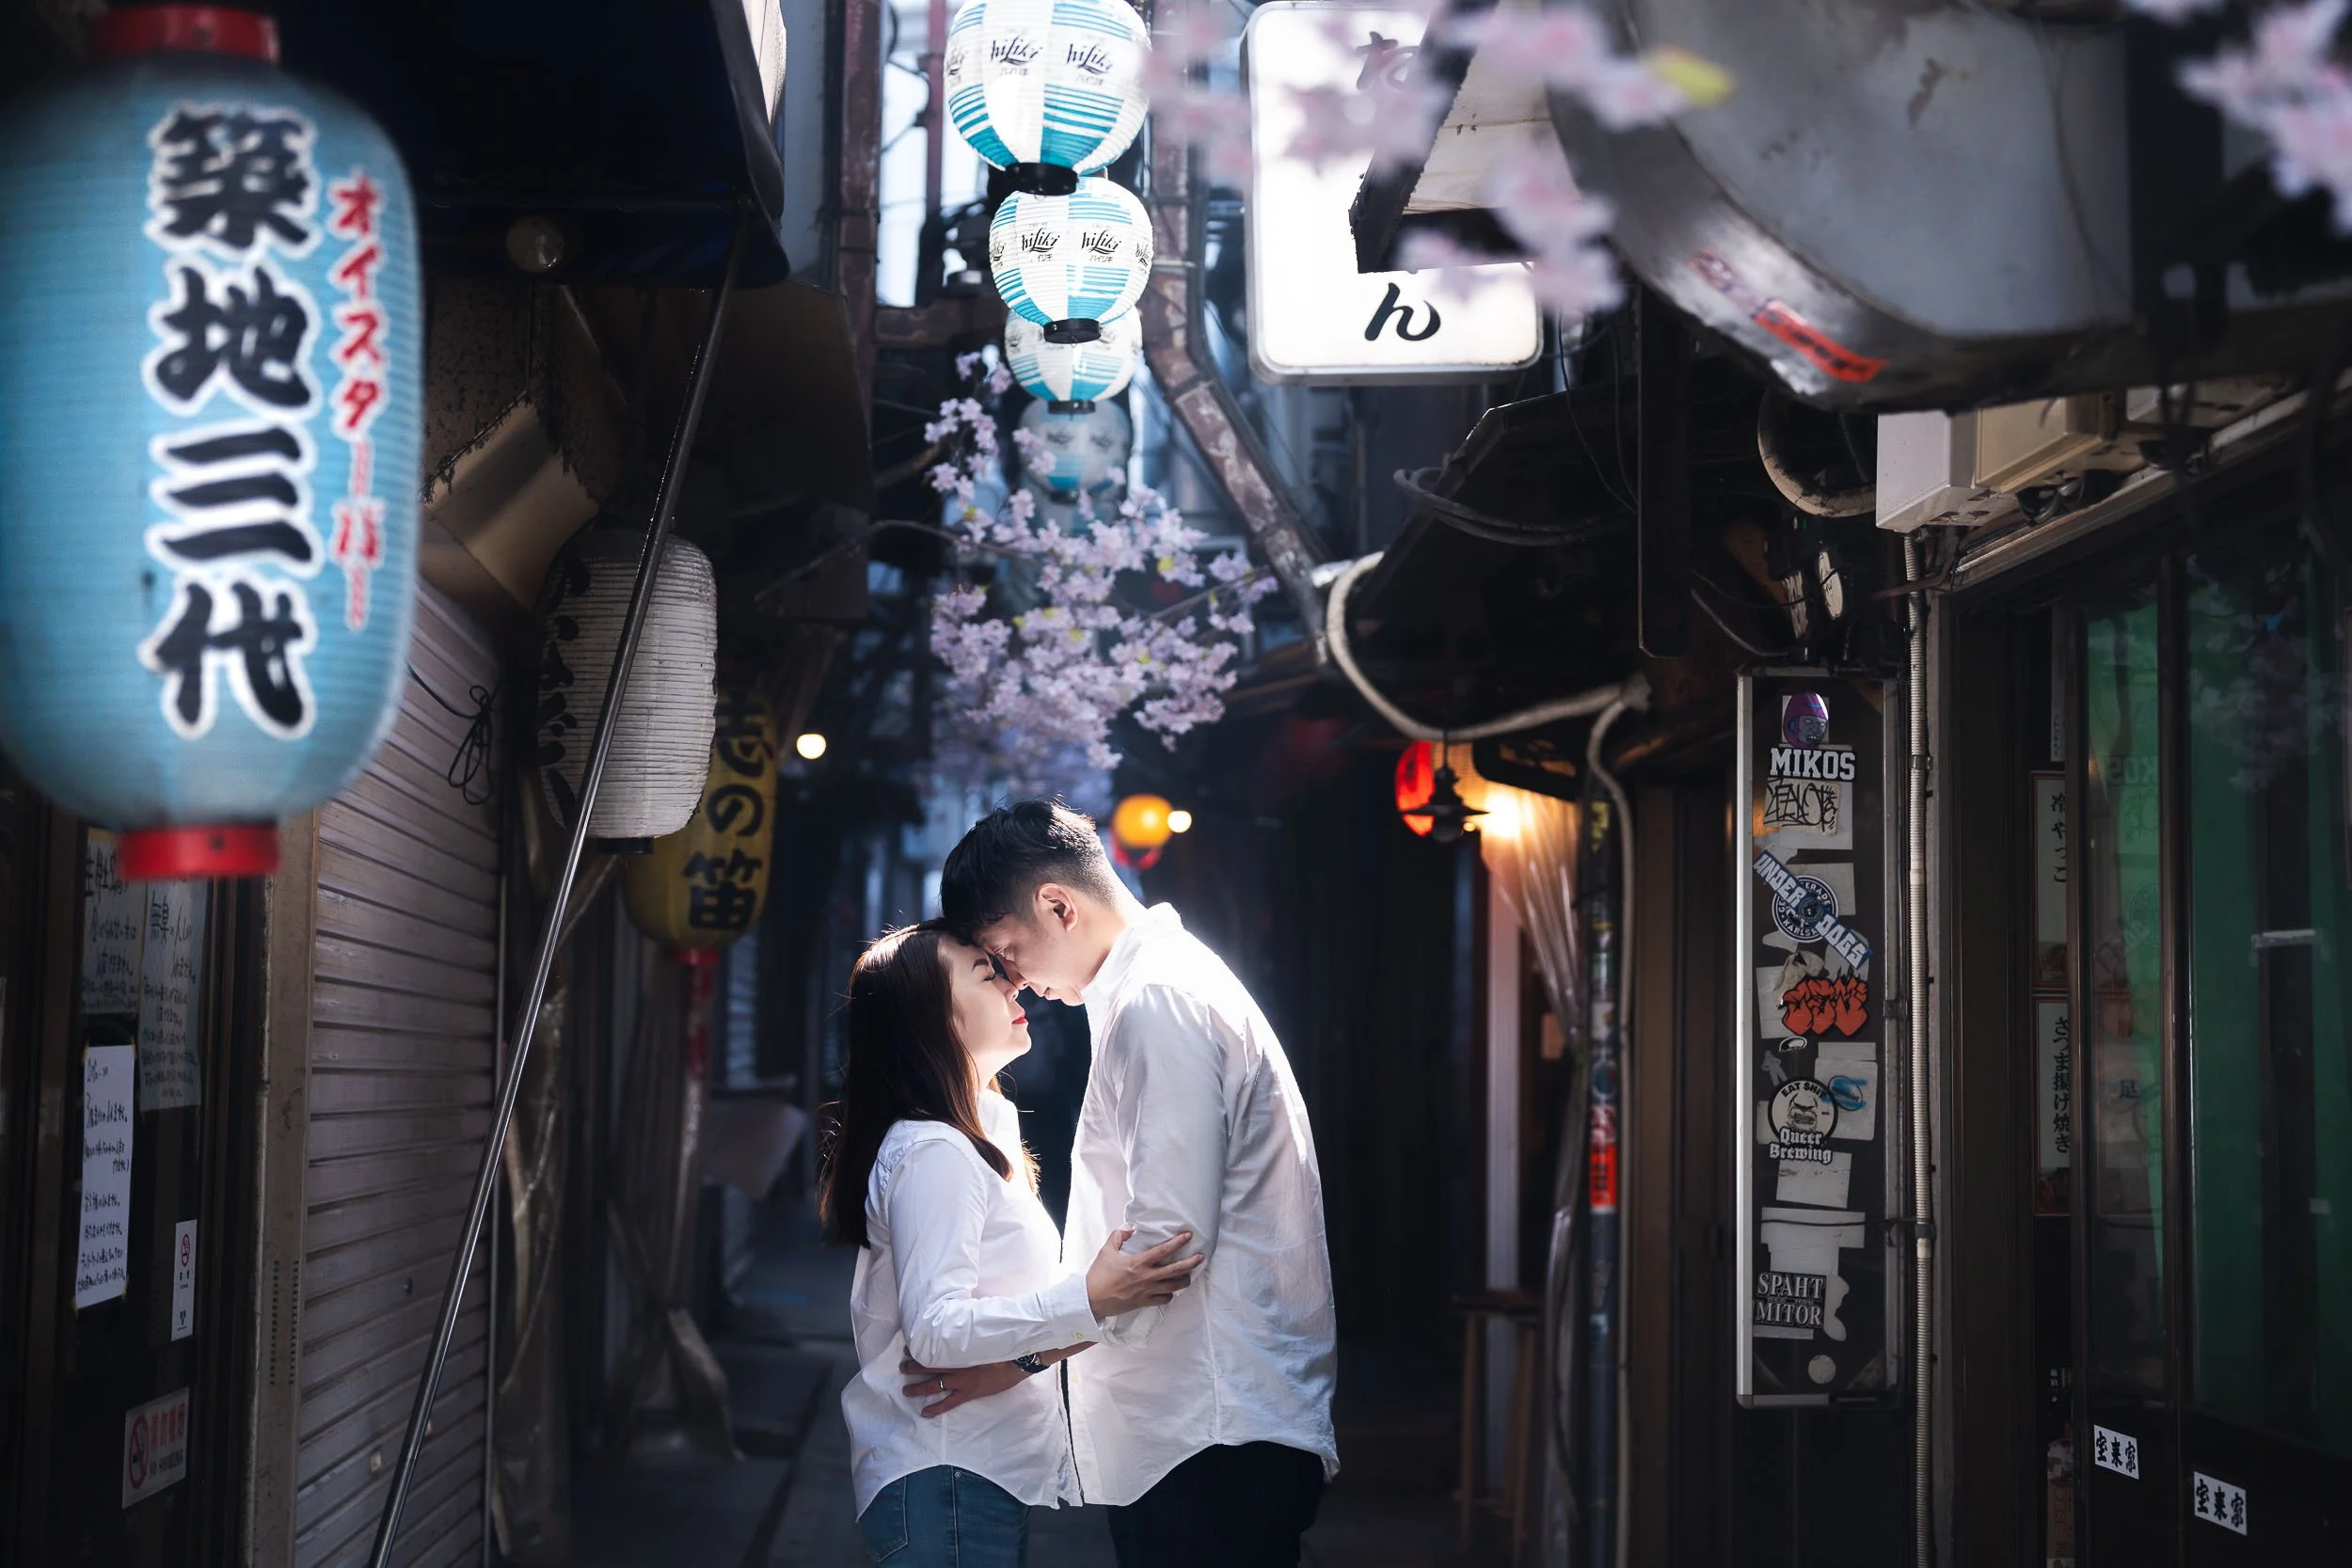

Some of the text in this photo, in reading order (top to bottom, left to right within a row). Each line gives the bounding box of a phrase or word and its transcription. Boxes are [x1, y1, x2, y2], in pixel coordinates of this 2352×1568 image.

[332, 173, 385, 627] オイスターバー
[149, 105, 316, 732] 築地三代
[1770, 747, 1856, 781] MIKOS
[1753, 854, 1867, 970] UNDER DOGS
[1781, 1082, 1801, 1098] EAT
[1780, 1128, 1822, 1146] Queer
[1769, 1143, 1832, 1164] Brewing
[1757, 1273, 1823, 1299] SPAHT
[1756, 1301, 1821, 1325] MITOR
